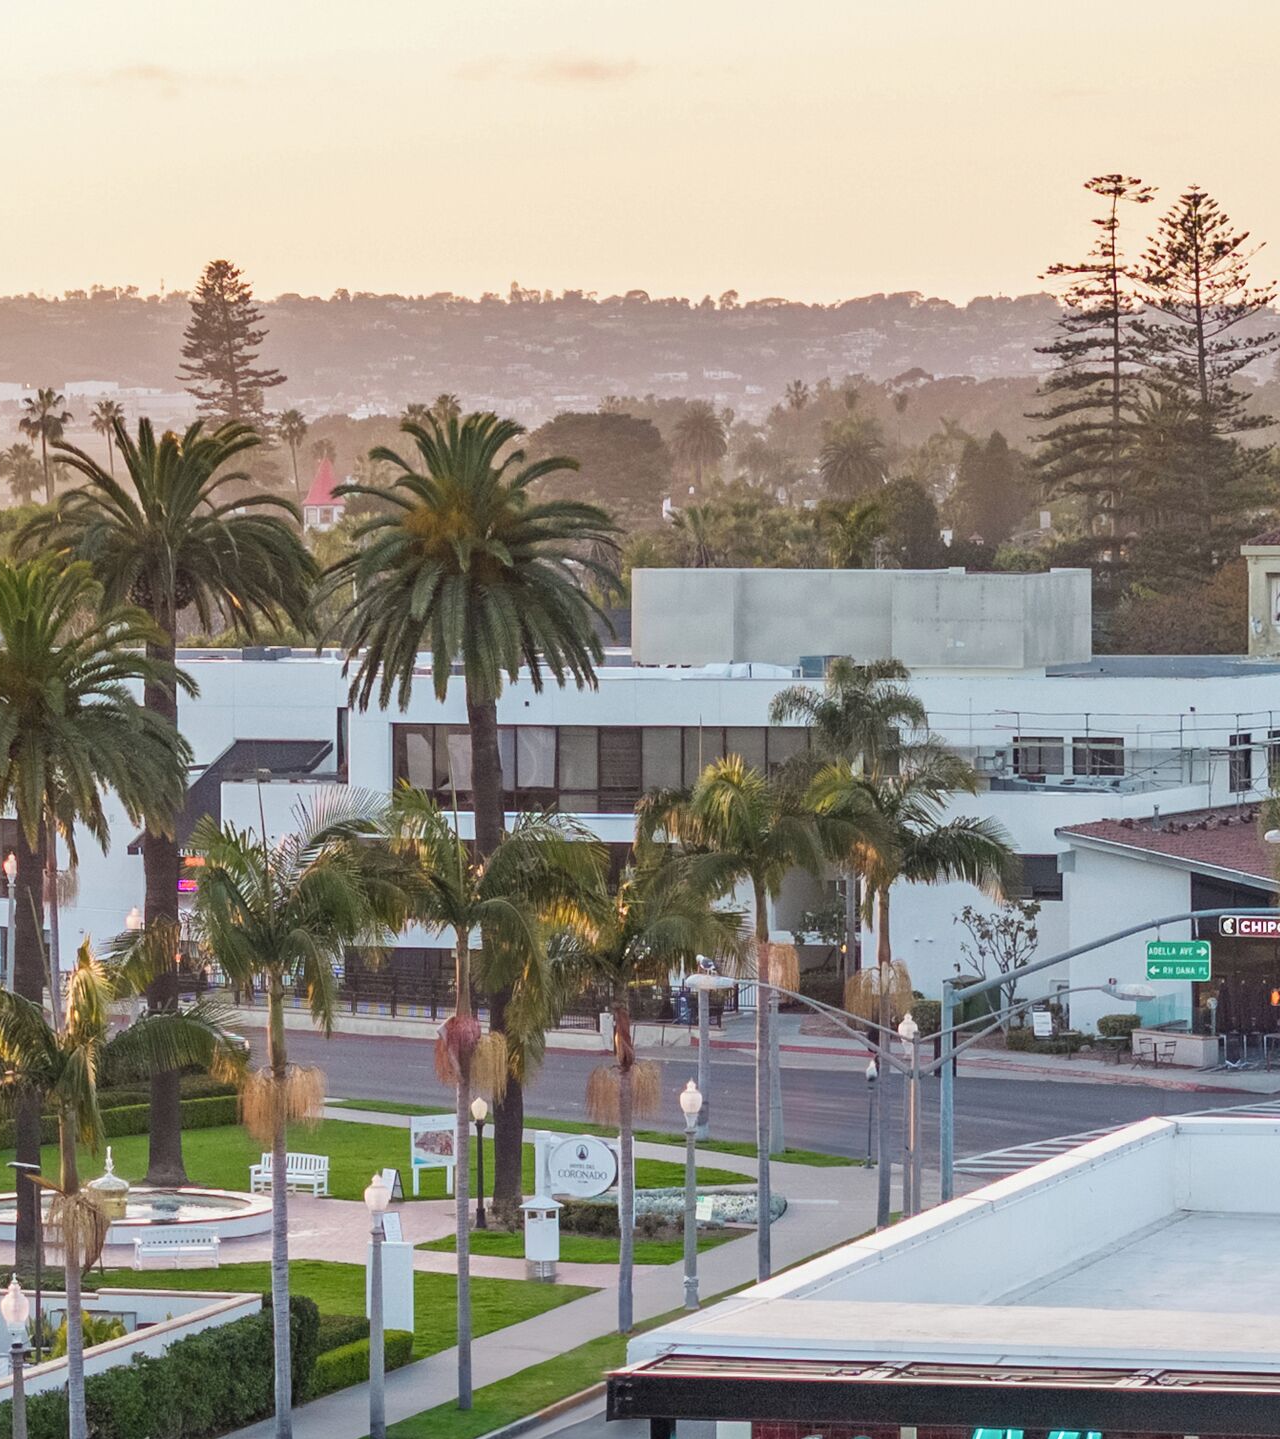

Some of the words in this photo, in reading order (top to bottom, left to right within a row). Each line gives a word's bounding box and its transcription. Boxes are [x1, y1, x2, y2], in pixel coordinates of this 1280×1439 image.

[1148, 947, 1177, 955] ADELLA
[1180, 947, 1193, 955] AVE
[1162, 967, 1173, 975] RH
[1176, 967, 1195, 975] DANA
[1198, 967, 1208, 975] PL
[558, 1169, 608, 1180] CORONADO
